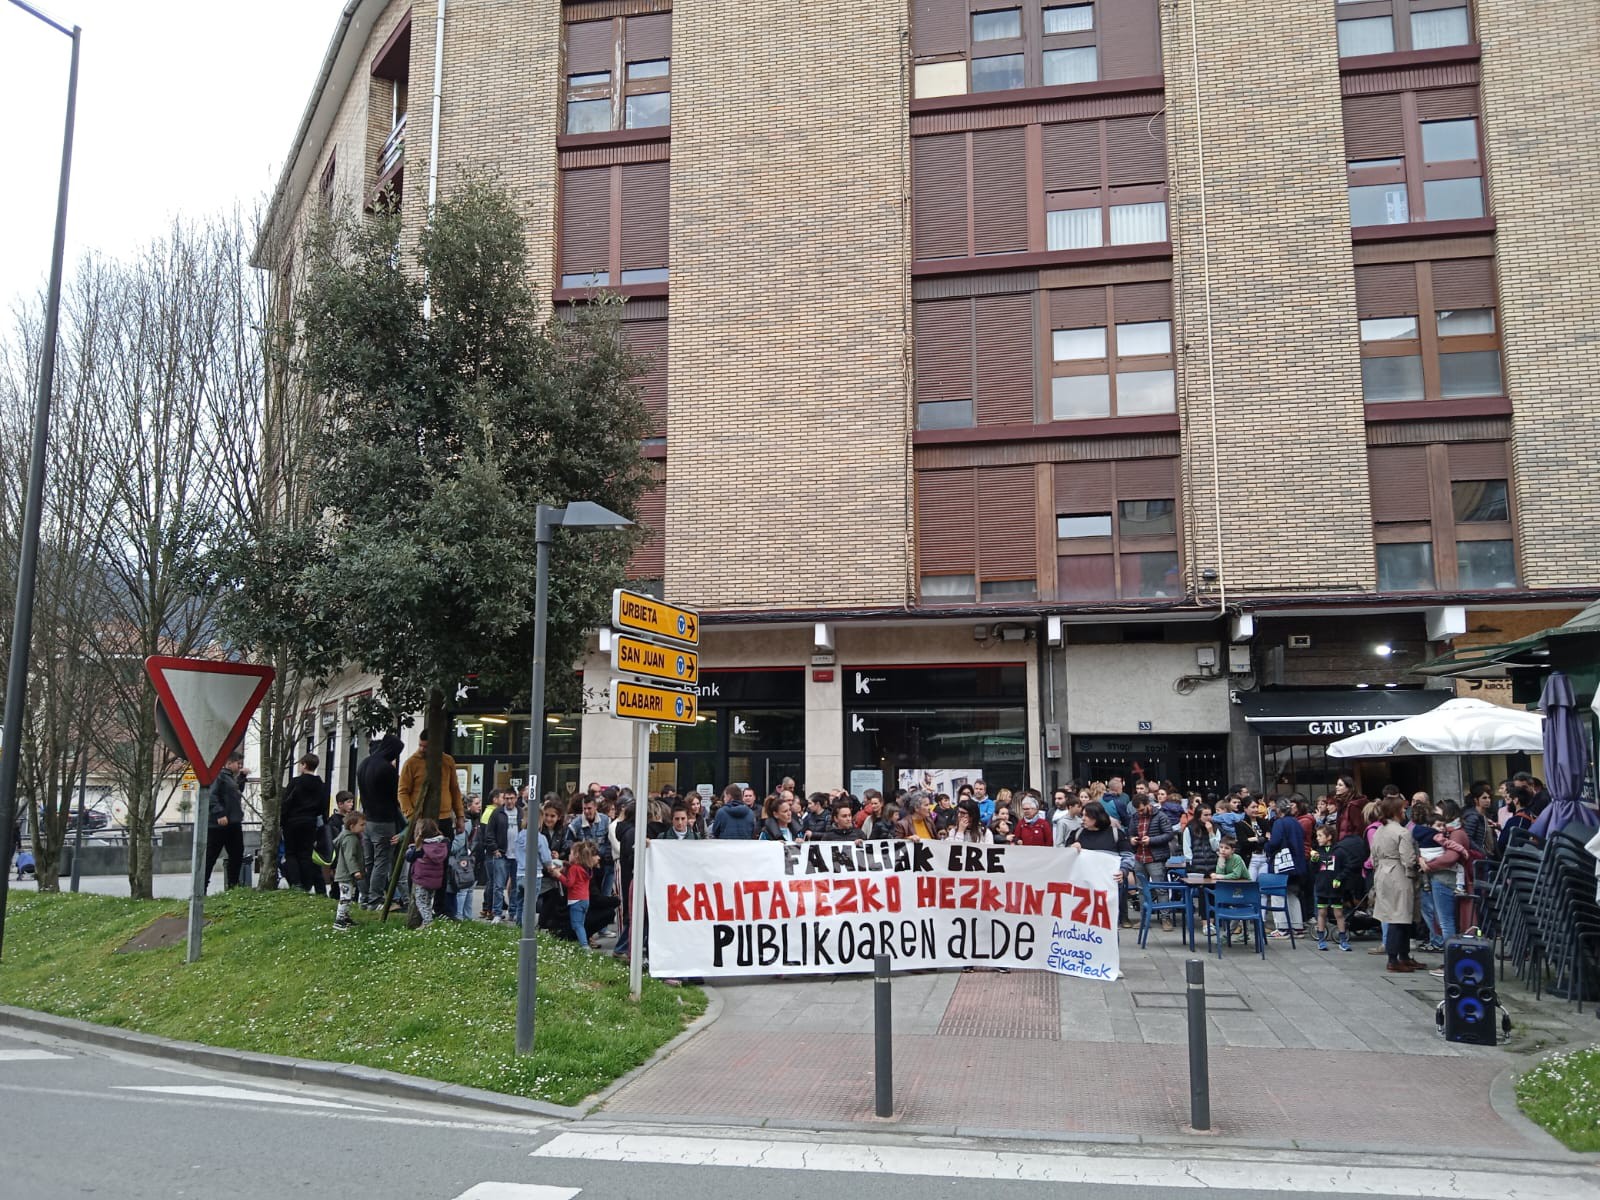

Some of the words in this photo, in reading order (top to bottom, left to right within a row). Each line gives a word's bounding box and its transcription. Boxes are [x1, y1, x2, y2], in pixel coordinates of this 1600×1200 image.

[621, 600, 658, 625] URBIETA
[620, 645, 640, 664] SAN
[642, 649, 665, 669] JUAN
[619, 690, 663, 712] OLABARRI
[1139, 722, 1151, 731] 33
[1308, 722, 1344, 734] GAU
[948, 845, 1006, 873] ERE
[667, 875, 902, 921] KALITATEZKO
[917, 876, 1112, 930] HEZKUNTZA
